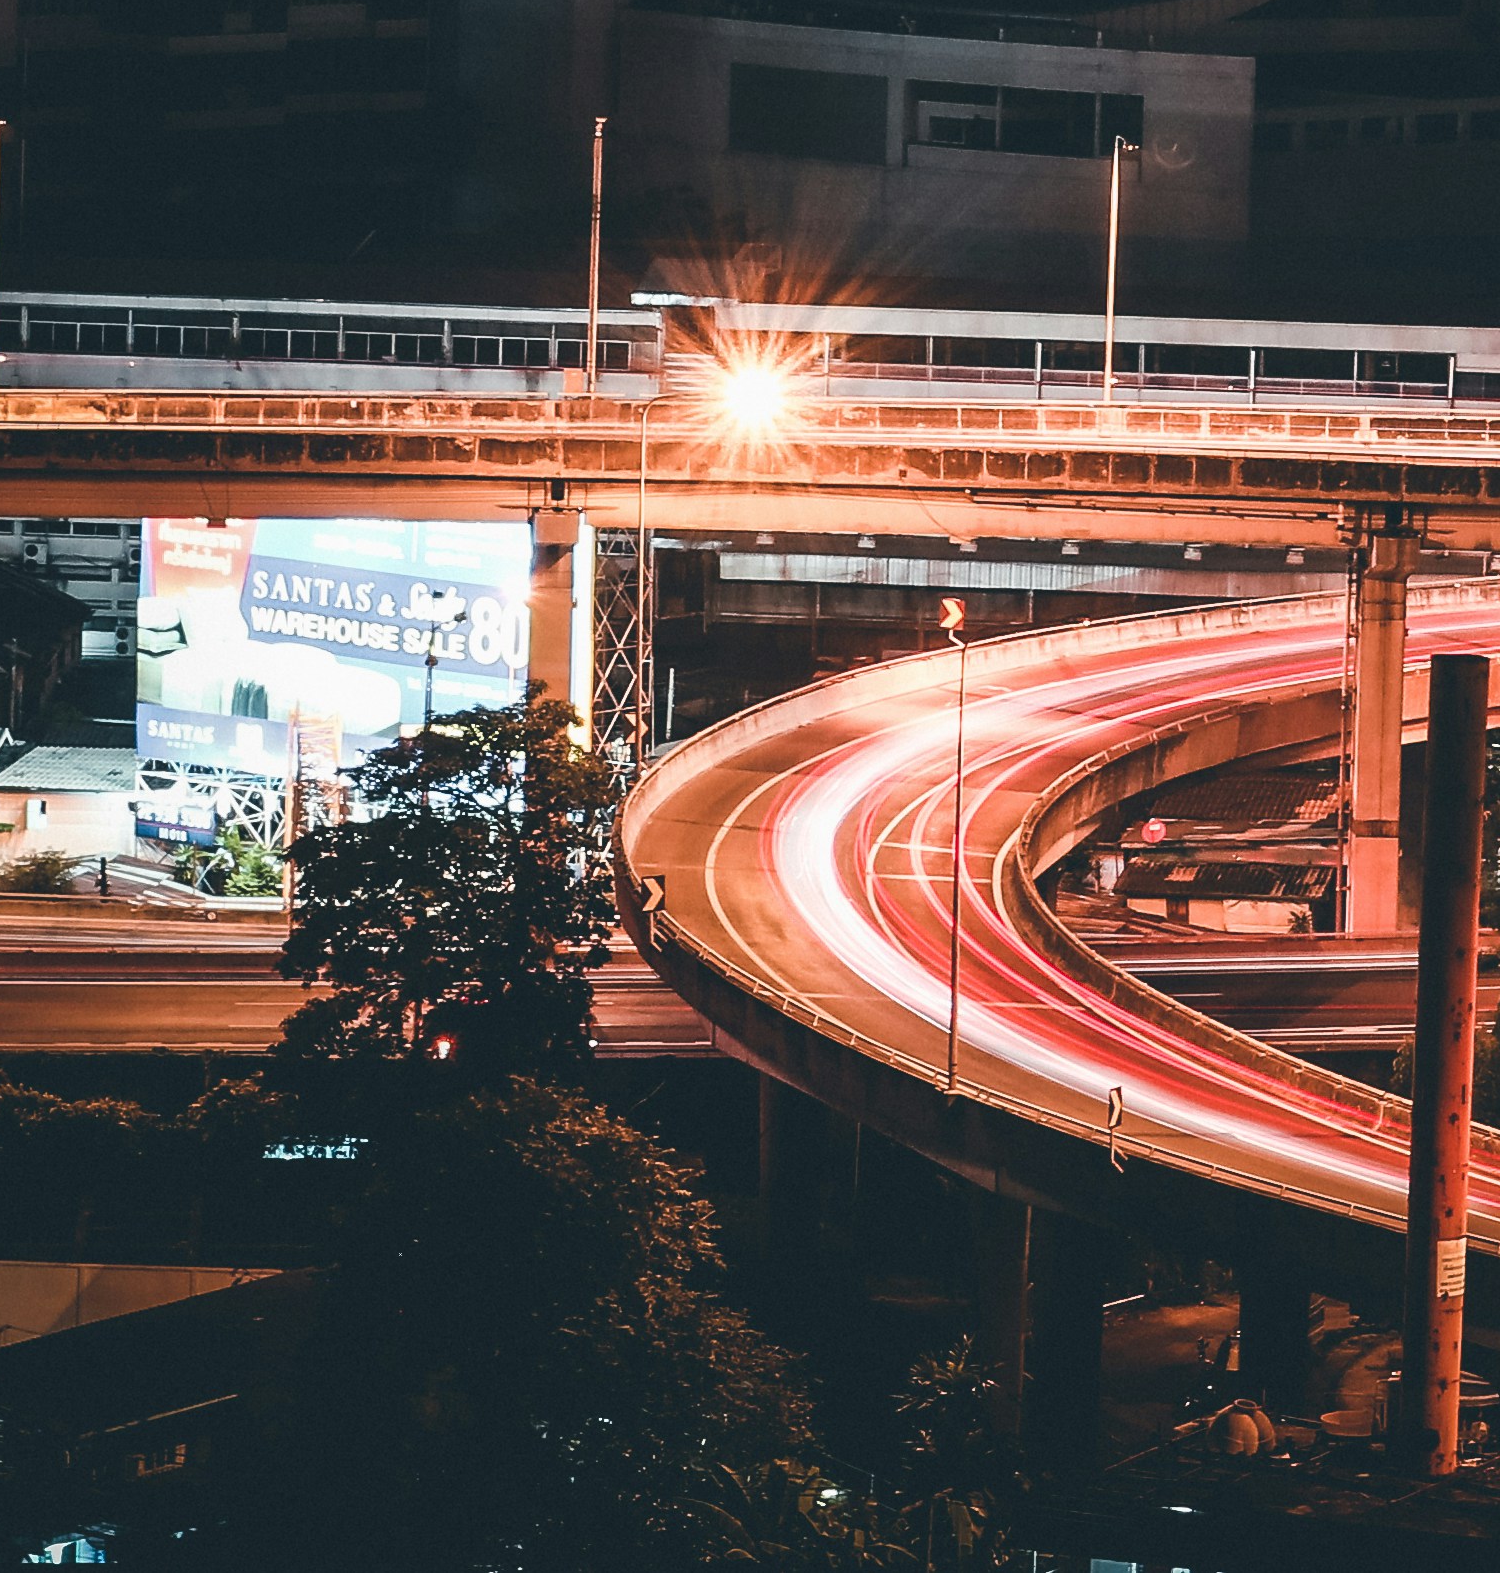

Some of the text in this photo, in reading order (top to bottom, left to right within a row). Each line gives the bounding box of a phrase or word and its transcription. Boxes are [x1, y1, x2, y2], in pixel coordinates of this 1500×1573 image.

[252, 570, 375, 612] SANTAS
[376, 594, 396, 617] &
[250, 606, 467, 661] WAREHOUSE SALE
[469, 596, 530, 669] 80
[148, 719, 215, 745] SANTAS
